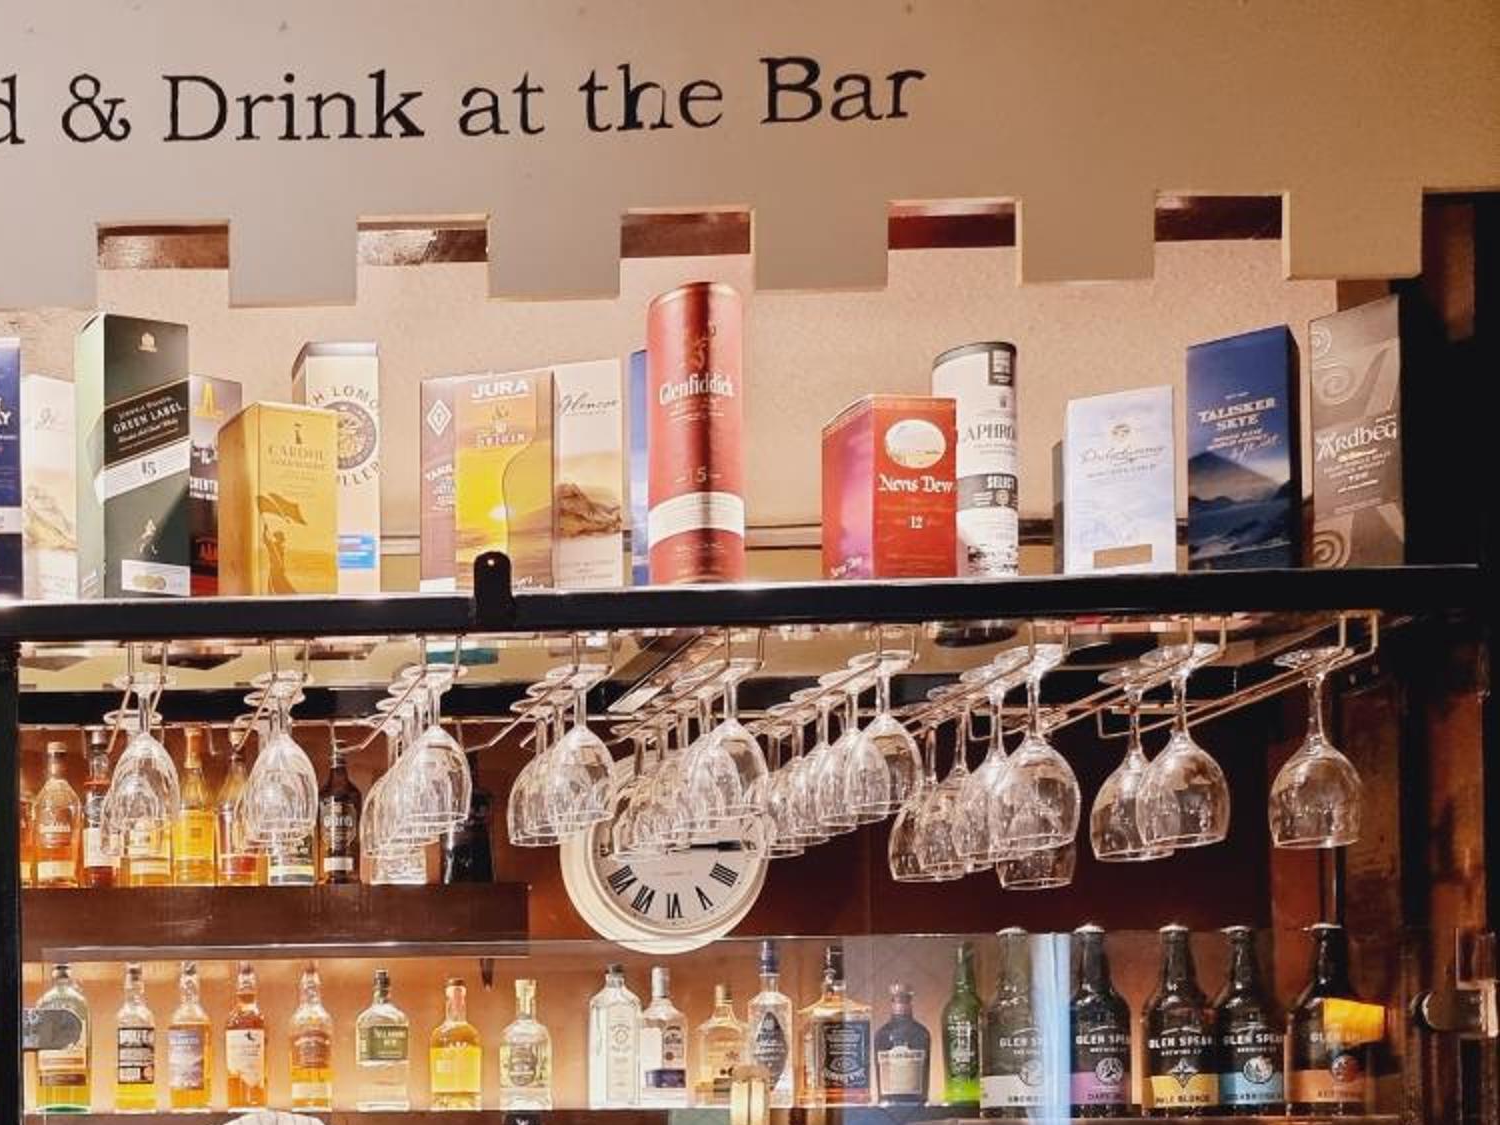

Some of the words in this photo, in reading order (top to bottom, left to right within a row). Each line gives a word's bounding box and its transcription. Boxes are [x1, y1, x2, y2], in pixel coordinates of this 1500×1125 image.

[61, 73, 133, 144] &
[162, 69, 425, 143] Drink
[458, 70, 545, 138] at
[580, 63, 726, 133] the
[760, 56, 927, 126] Bar
[470, 379, 531, 399] JURA
[658, 371, 736, 406] Glenfiddich
[112, 414, 149, 435] GREEN
[149, 401, 184, 421] LABEL
[1197, 397, 1276, 424] TALISKER
[965, 423, 1017, 442] APHRO
[1215, 413, 1260, 432] SKYE
[141, 461, 157, 476] 15
[878, 473, 919, 493] Nevis
[920, 474, 954, 494] Dew
[1075, 1034, 1106, 1046] GLEN
[1148, 1036, 1176, 1049] GLEN
